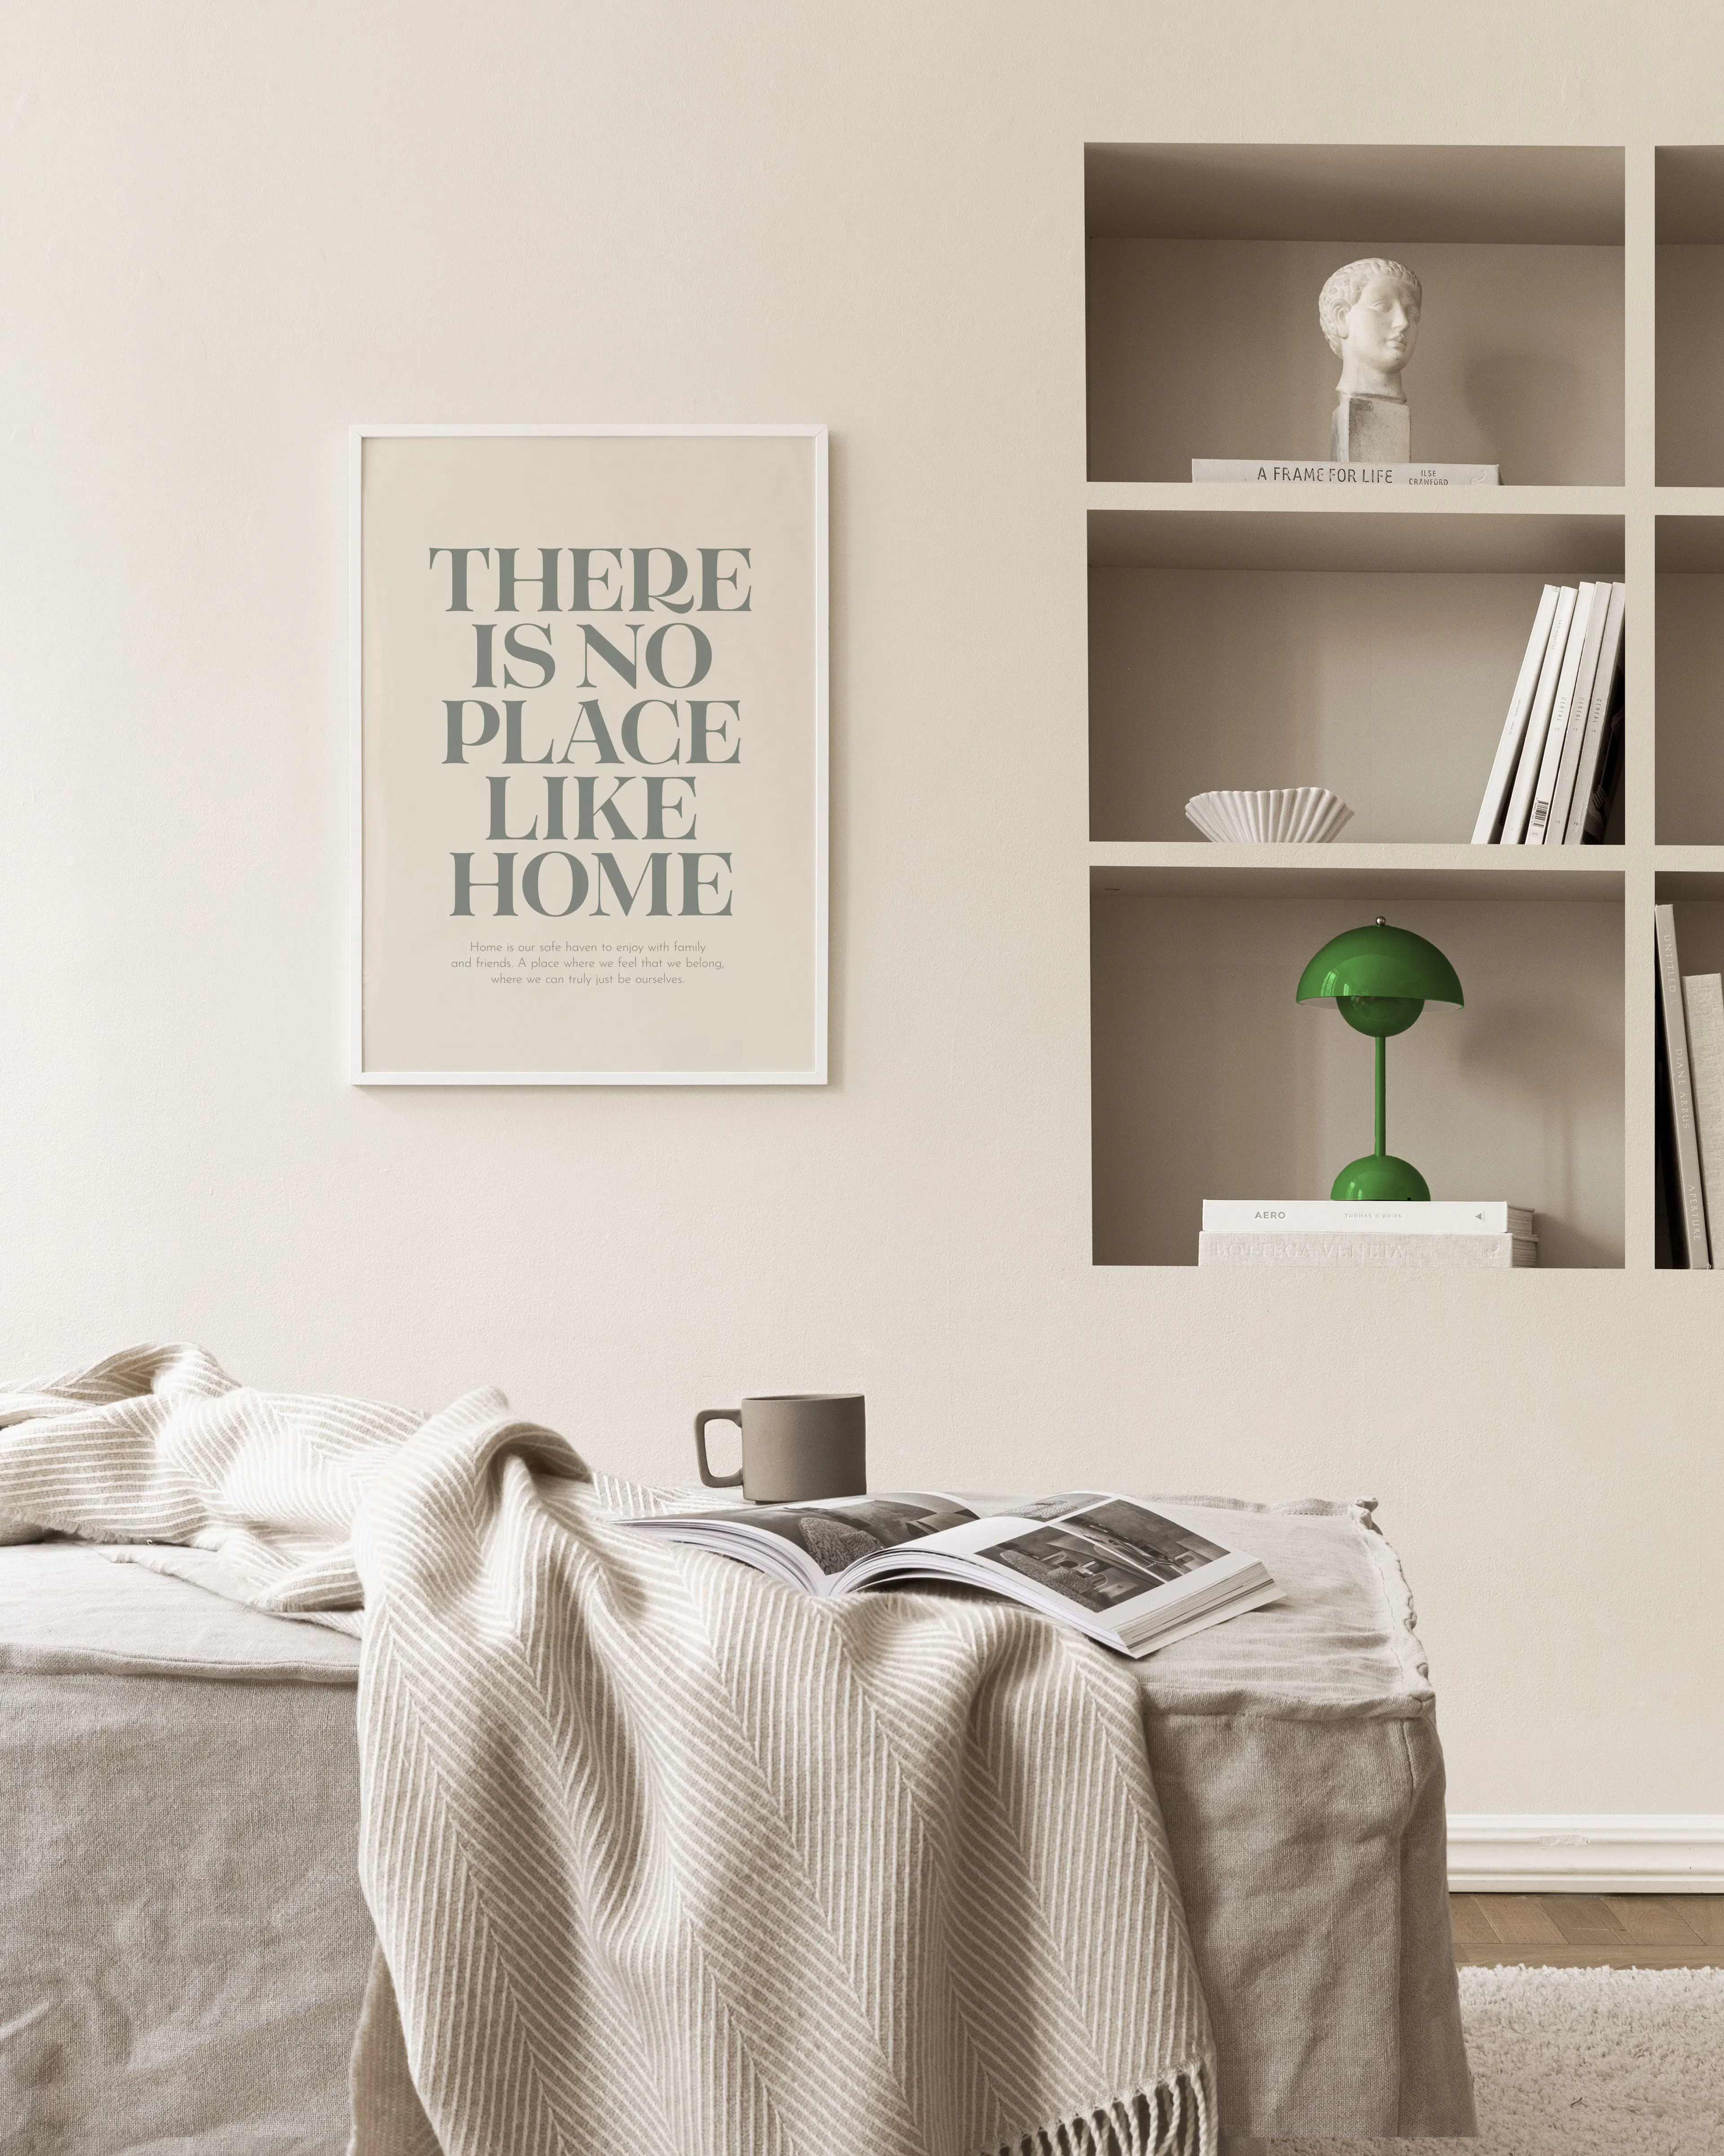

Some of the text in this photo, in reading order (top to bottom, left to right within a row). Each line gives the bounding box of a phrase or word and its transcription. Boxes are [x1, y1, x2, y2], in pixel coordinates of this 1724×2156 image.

[1258, 467, 1393, 484] A FRAME FOR LIFE
[429, 547, 752, 613] THERE
[472, 623, 712, 689] IS NO
[442, 699, 741, 765] PLACE
[1557, 697, 1566, 721] CEREAL
[1575, 697, 1584, 721] CEREAL
[1593, 698, 1602, 723] CEREAL
[485, 776, 697, 840] LIKE
[450, 851, 733, 917] HOME
[451, 957, 471, 968] and
[476, 957, 513, 968] friends.
[518, 957, 527, 968] A
[531, 956, 559, 970] place
[563, 957, 595, 968] where
[618, 956, 637, 968] feel
[641, 957, 663, 968] that
[686, 956, 724, 970] belong,
[471, 941, 502, 952] Home
[507, 943, 514, 952] is
[540, 940, 561, 952] safe
[566, 940, 597, 952] haven
[601, 943, 612, 952] to
[616, 943, 644, 954] enjoy
[648, 940, 669, 952] with
[673, 940, 706, 954] family
[1663, 935, 1676, 992] UNTITLED
[491, 972, 523, 983] where
[568, 972, 592, 986] truly
[596, 975, 614, 986] just
[618, 972, 631, 983] be
[635, 972, 685, 983] ourselves.
[1676, 1049, 1690, 1129] DIANE ARBUS
[1689, 1184, 1701, 1240] APERTURE
